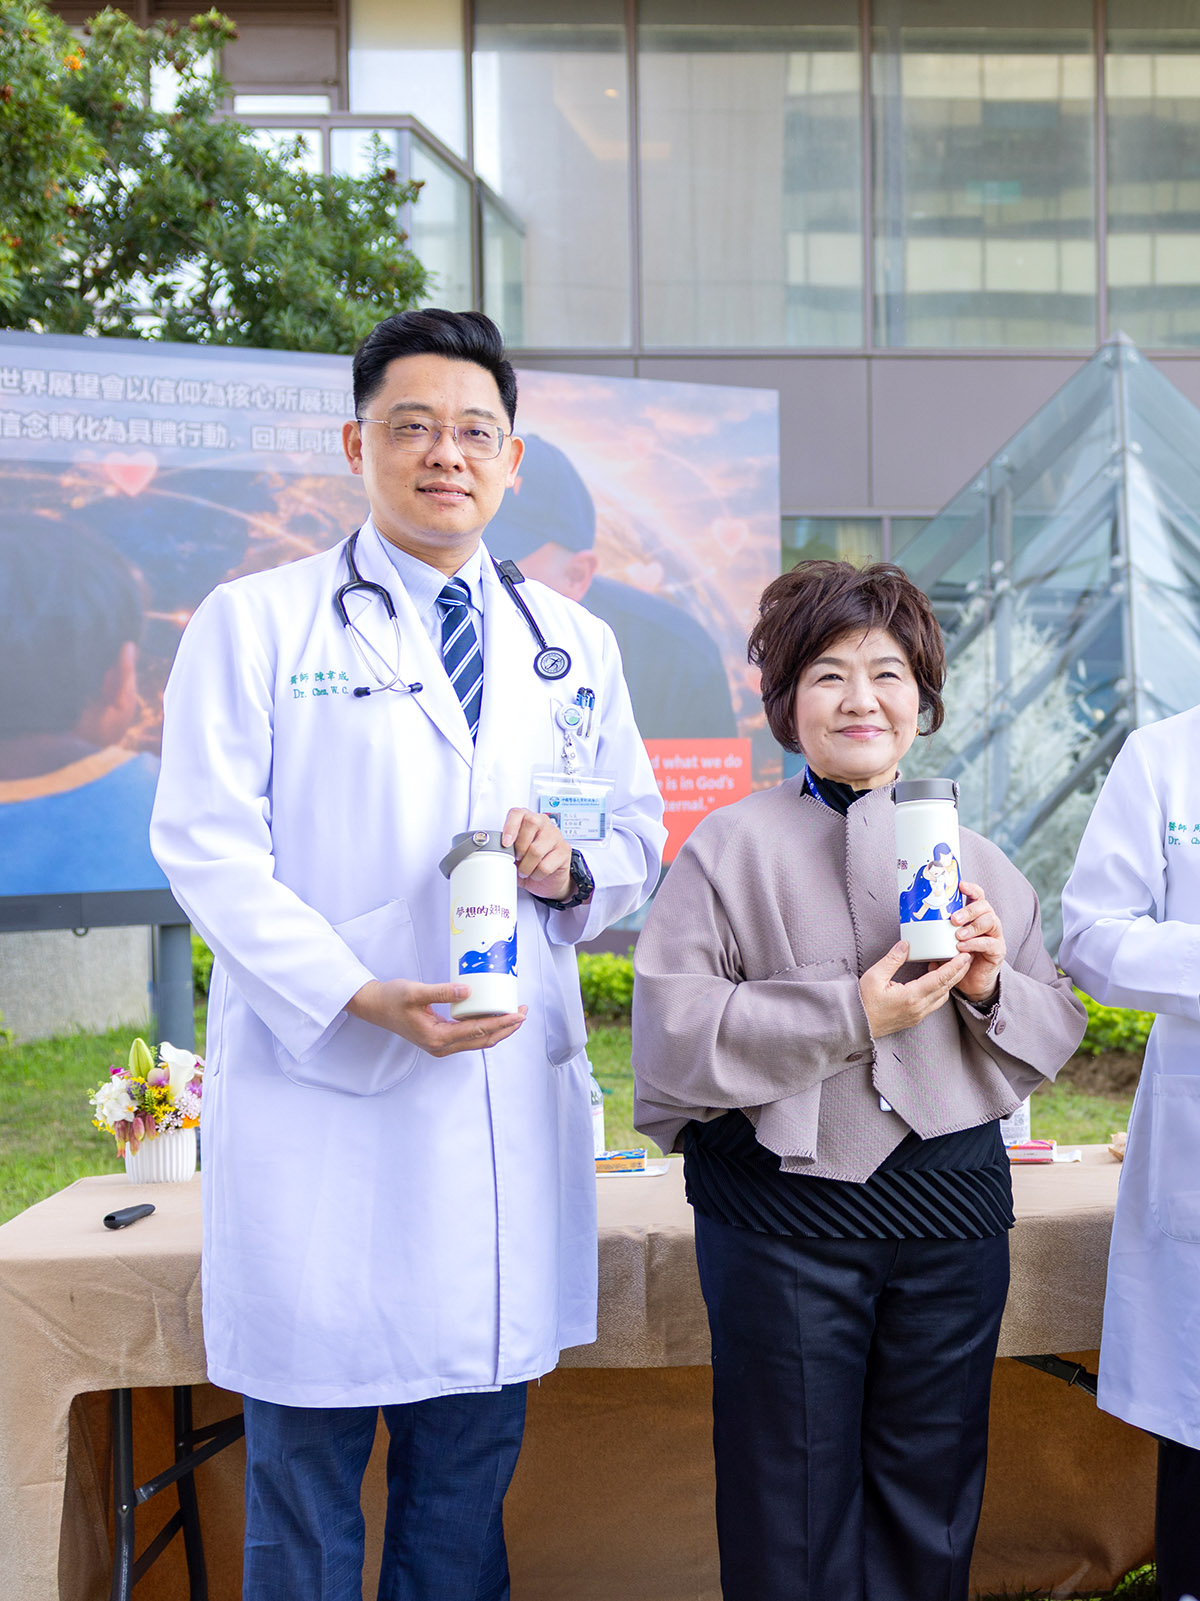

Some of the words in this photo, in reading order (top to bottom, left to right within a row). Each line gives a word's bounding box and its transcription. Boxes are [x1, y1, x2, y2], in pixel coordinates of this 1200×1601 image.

[293, 688, 307, 699] Dr.
[662, 754, 699, 769] what
[701, 757, 722, 769] we
[723, 753, 743, 769] do
[665, 775, 678, 791] is
[680, 775, 694, 791] in
[696, 774, 735, 790] God's
[664, 796, 715, 812] ternal."
[1167, 821, 1188, 833] 醫師
[1168, 835, 1181, 846] Dr.
